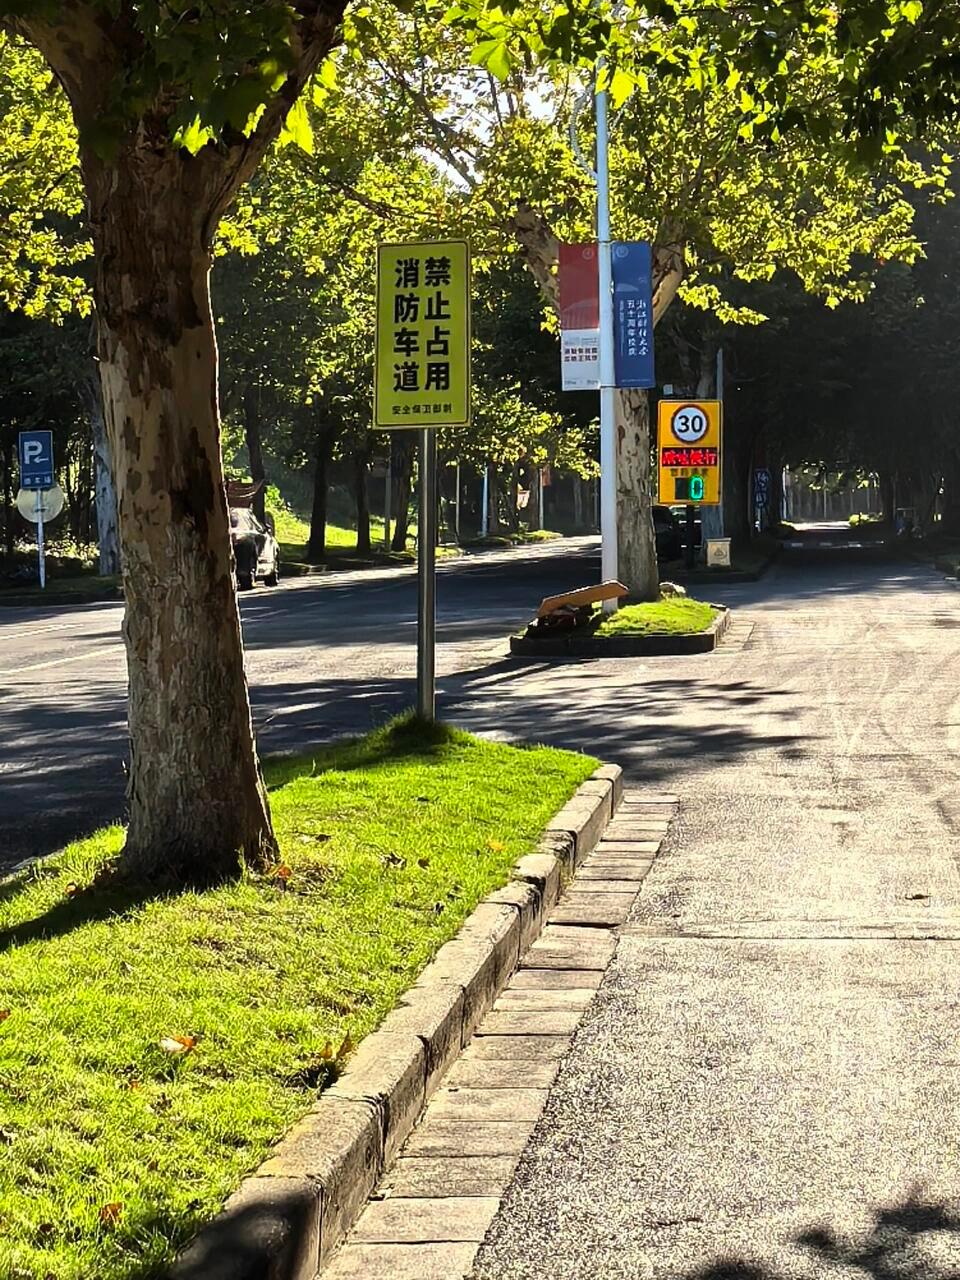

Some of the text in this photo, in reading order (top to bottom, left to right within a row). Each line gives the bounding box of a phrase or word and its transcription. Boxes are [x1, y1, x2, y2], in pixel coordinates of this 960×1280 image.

[393, 257, 420, 392] 消防车道
[424, 256, 451, 391] 禁止占用
[678, 415, 703, 433] 30
[24, 441, 43, 464] P
[691, 476, 703, 499] 0
